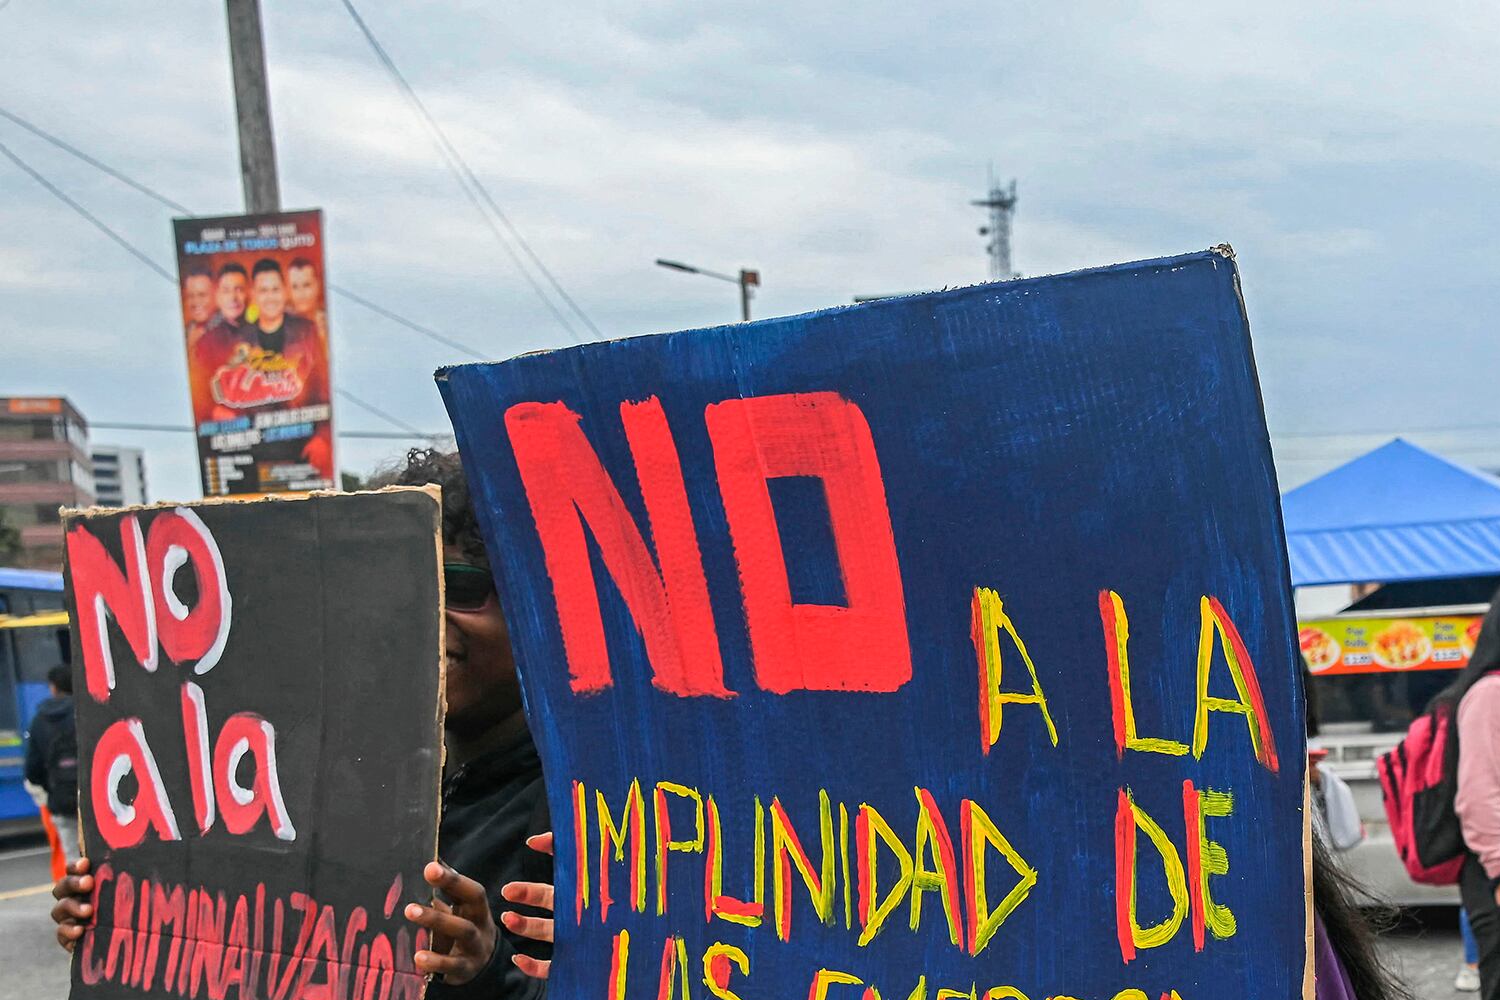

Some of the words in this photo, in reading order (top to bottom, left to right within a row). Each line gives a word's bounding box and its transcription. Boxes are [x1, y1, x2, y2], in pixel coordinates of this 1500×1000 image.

[67, 506, 231, 701] NO
[503, 390, 913, 700] NO
[92, 717, 182, 849] a
[180, 680, 296, 842] la
[969, 586, 1058, 757] A
[1098, 588, 1280, 775] LA
[572, 774, 1039, 957] IMPUNIDAD
[1114, 778, 1238, 965] DE
